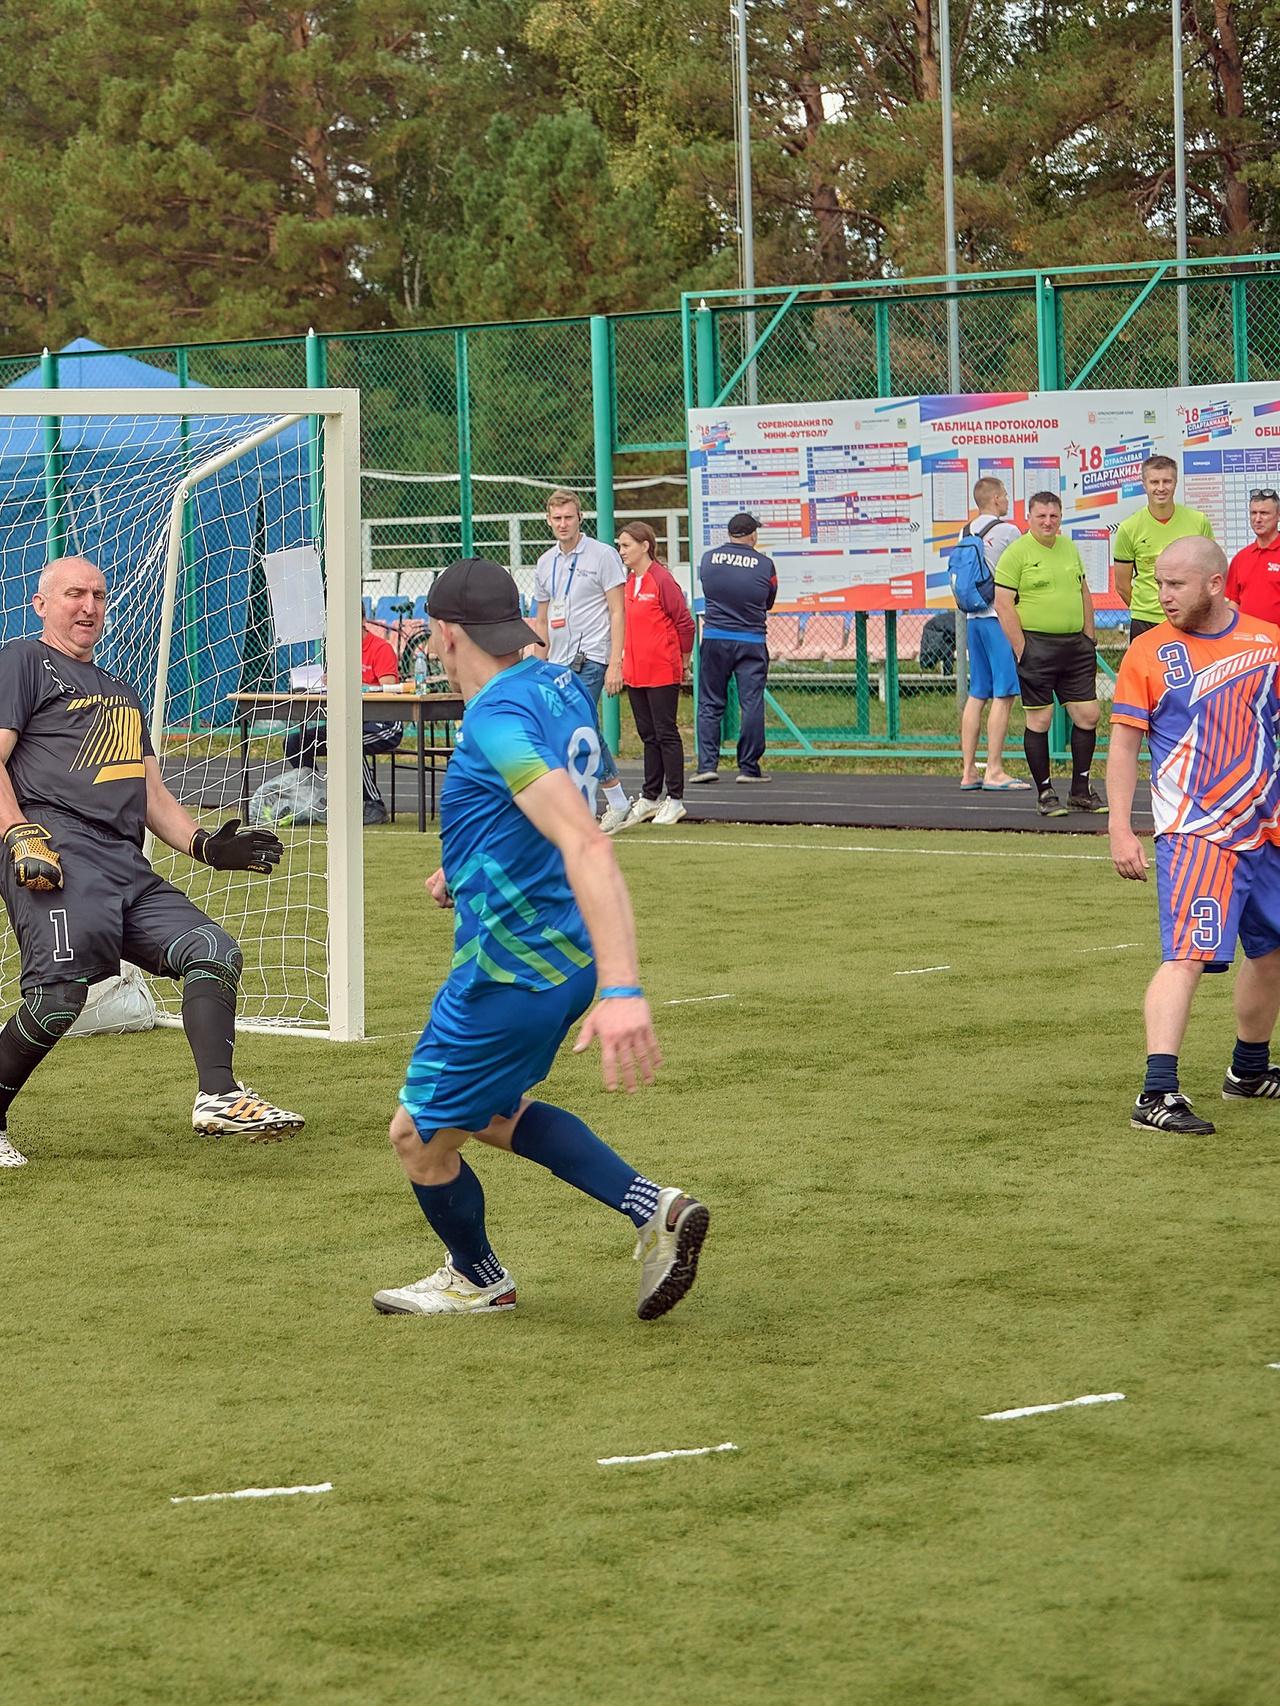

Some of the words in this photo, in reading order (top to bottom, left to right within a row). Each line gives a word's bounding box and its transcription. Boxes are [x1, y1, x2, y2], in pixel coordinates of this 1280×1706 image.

[757, 419, 820, 429] СОРЕВНОВАНИЯ
[821, 418, 834, 427] ПО
[1185, 408, 1199, 424] 18
[931, 420, 983, 432] ТАБЛИЦА
[984, 419, 1059, 431] ПРОТОКОЛОВ
[763, 430, 828, 439] МИНИ-ФУТБОЛУ
[951, 431, 1039, 445] СОРЕВНОВАНИЙ
[1079, 445, 1102, 472] 18
[1104, 452, 1143, 467] ОТРАСЛЕВАЯ
[1083, 463, 1142, 484] СПАРТАКИА
[711, 553, 759, 568] КРУДОР
[1157, 640, 1195, 690] 3
[567, 726, 601, 820] 8
[1190, 897, 1222, 951] 3
[49, 908, 74, 962] 1
